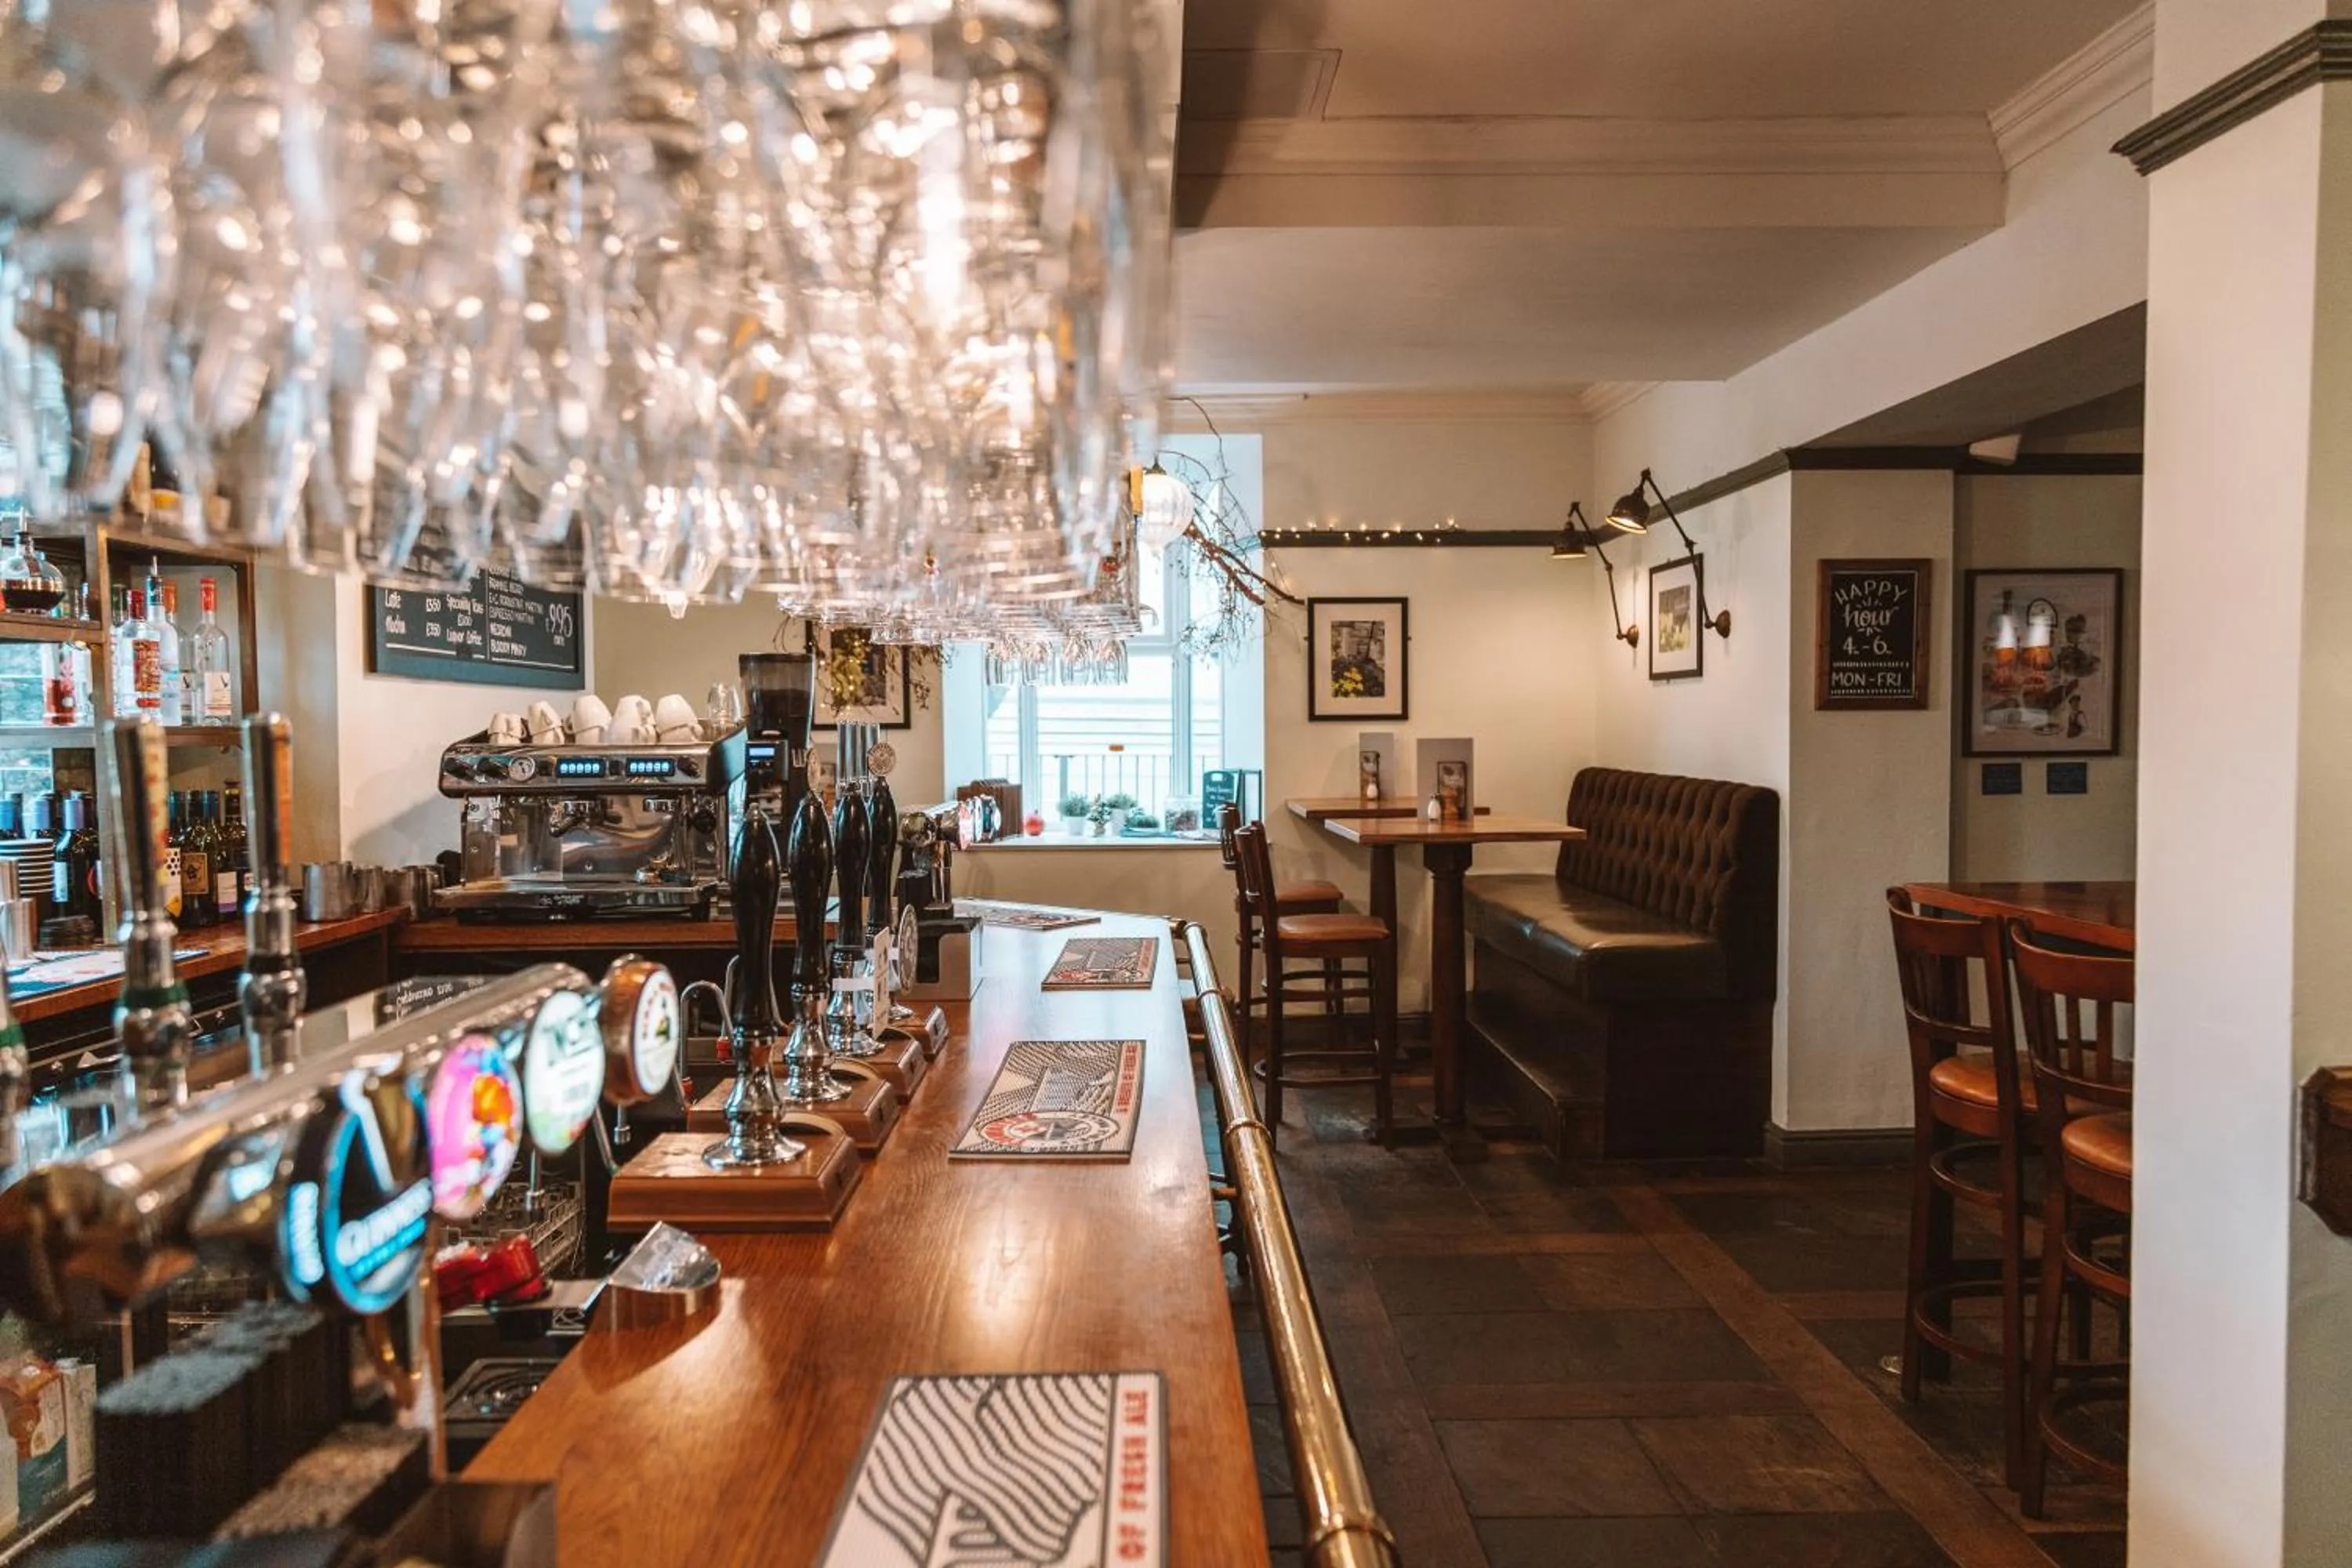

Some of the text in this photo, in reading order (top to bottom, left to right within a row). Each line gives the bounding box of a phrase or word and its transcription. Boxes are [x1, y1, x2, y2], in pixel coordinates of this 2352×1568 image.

[1835, 580, 1907, 605] HAPPY
[1842, 603, 1900, 628] hour
[1118, 1392, 1147, 1561] OF FRESH ALE
